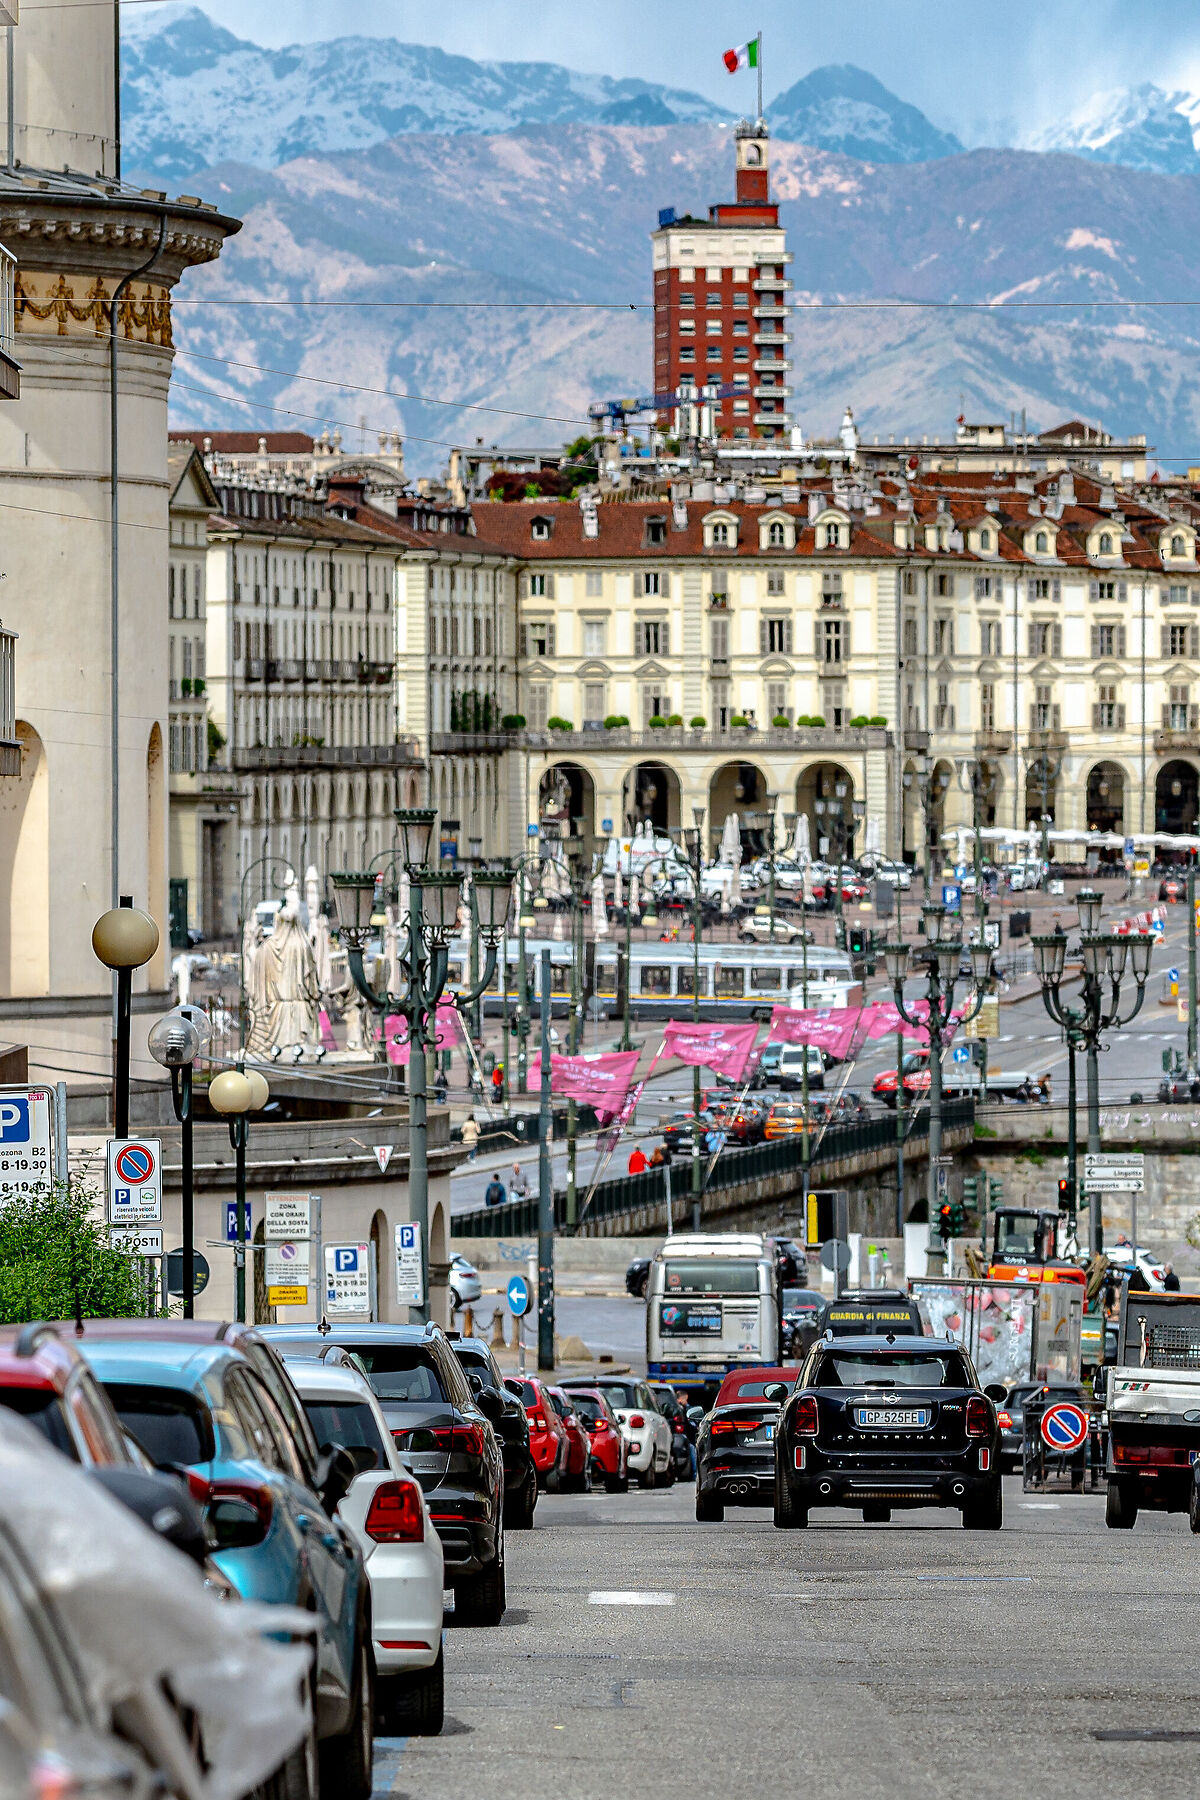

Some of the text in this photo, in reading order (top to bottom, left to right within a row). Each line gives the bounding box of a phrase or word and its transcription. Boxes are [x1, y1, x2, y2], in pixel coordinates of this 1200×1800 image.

[0, 1104, 20, 1138] P
[32, 1147, 46, 1156] B2
[1, 1160, 47, 1170] 8-19.30
[118, 1191, 128, 1203] P
[126, 1237, 159, 1247] POSTI
[403, 1229, 413, 1246] P
[340, 1251, 355, 1270] P
[830, 1312, 864, 1320] GUARDIA
[876, 1312, 911, 1320] FINANZA
[867, 1412, 918, 1423] GP 525FE
